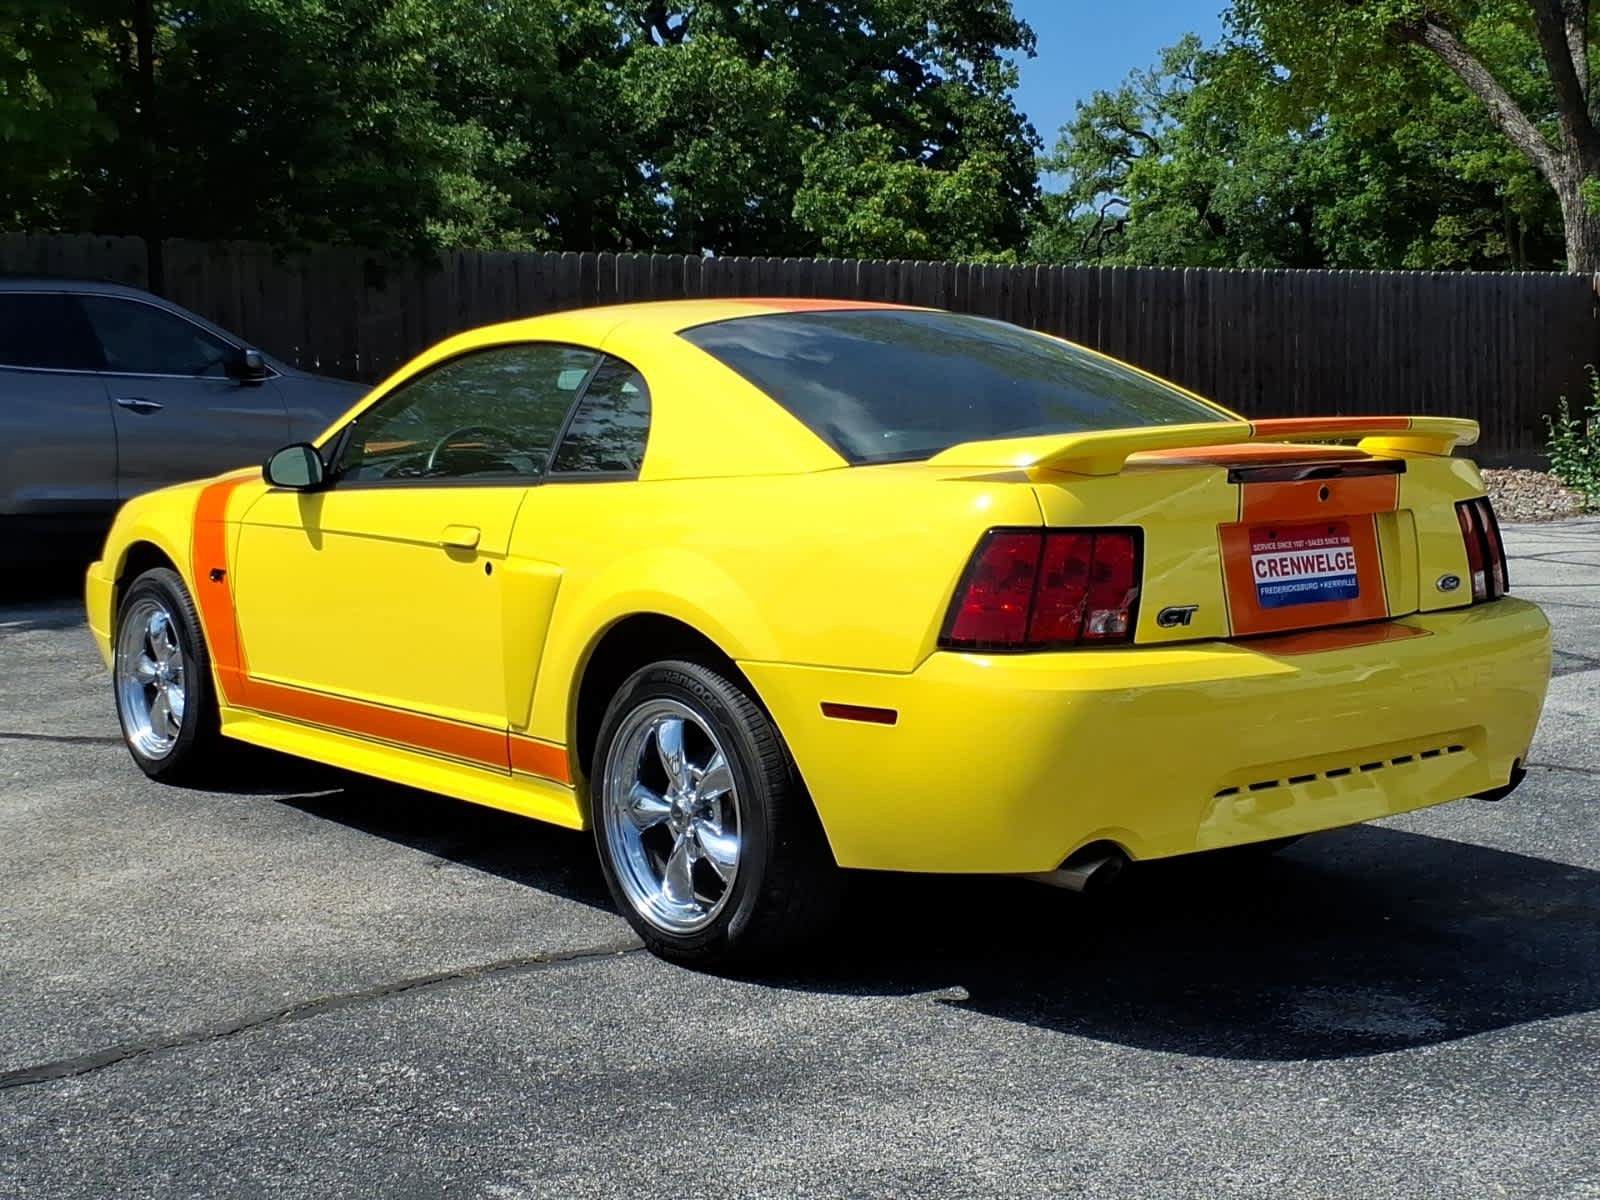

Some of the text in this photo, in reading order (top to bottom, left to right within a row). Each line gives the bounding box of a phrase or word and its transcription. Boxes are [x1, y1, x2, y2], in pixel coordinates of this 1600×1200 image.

[1253, 542, 1276, 552] SERVICE
[1277, 541, 1292, 549] SINCE
[1308, 538, 1324, 546] SALES
[1325, 537, 1339, 545] SINCE
[1255, 552, 1354, 578] CRENWELGE
[1260, 578, 1356, 595] FREDERICKSBURG KERRVILLE
[1156, 604, 1200, 628] GT
